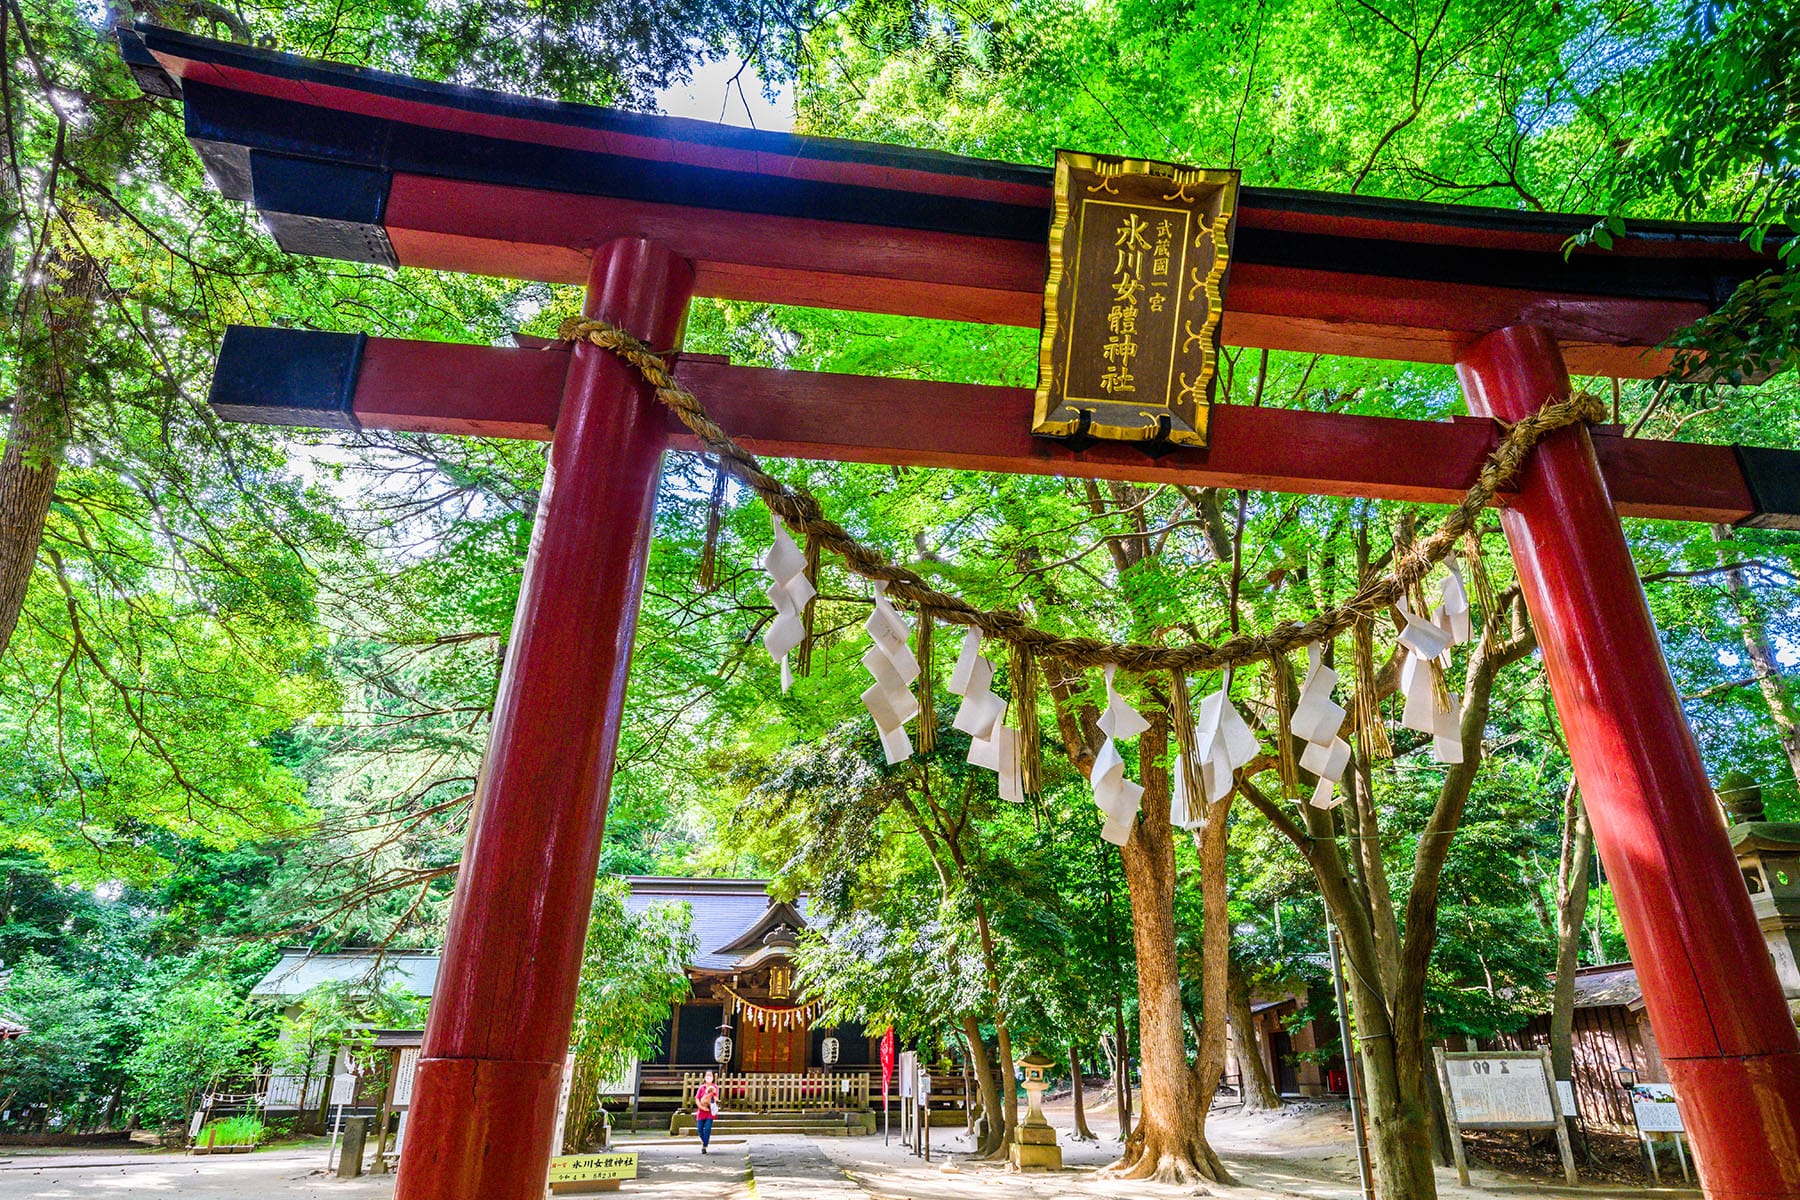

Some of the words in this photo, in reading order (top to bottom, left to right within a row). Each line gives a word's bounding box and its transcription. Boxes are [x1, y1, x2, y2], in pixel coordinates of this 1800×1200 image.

[1100, 213, 1151, 394] 氷川女體神社
